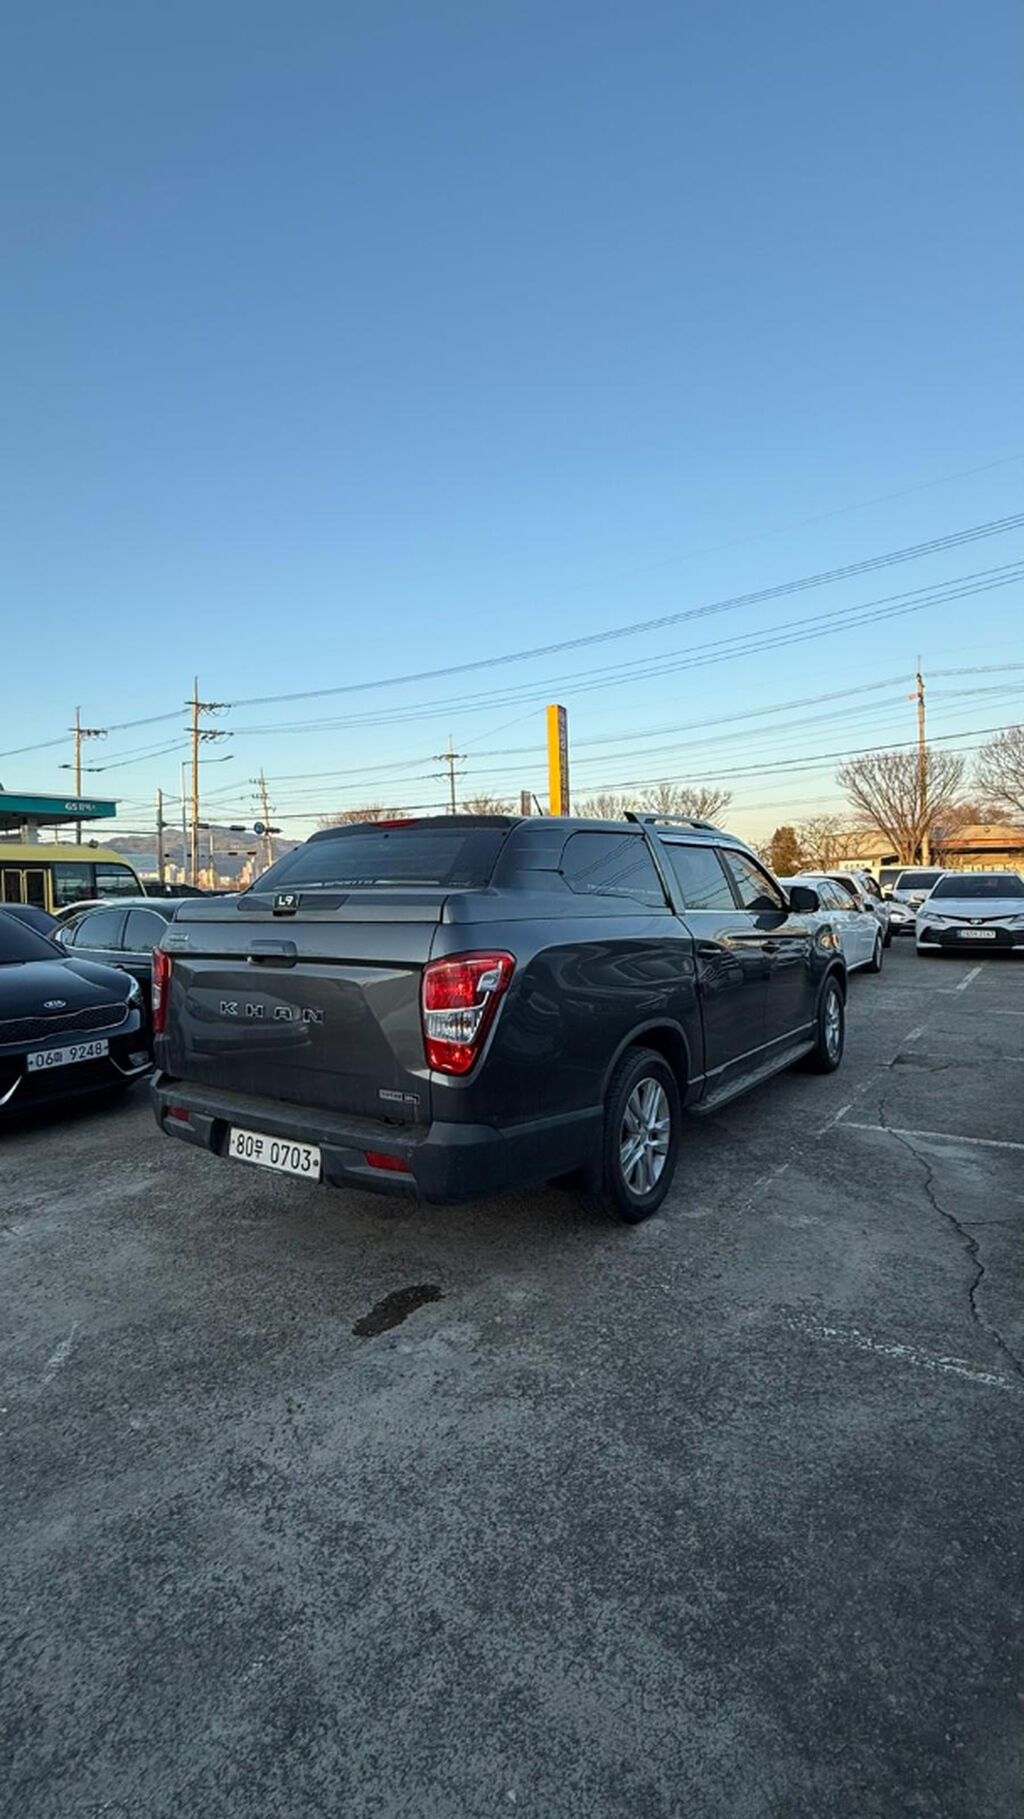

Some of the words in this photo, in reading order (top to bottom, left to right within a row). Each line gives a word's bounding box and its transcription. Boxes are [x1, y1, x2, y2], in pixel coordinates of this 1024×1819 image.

[65, 802, 78, 811] GS
[278, 895, 294, 906] L9
[219, 1000, 324, 1023] KHAN
[69, 1042, 103, 1060] 9248
[236, 1134, 263, 1158] 80무
[270, 1142, 312, 1171] 0703
